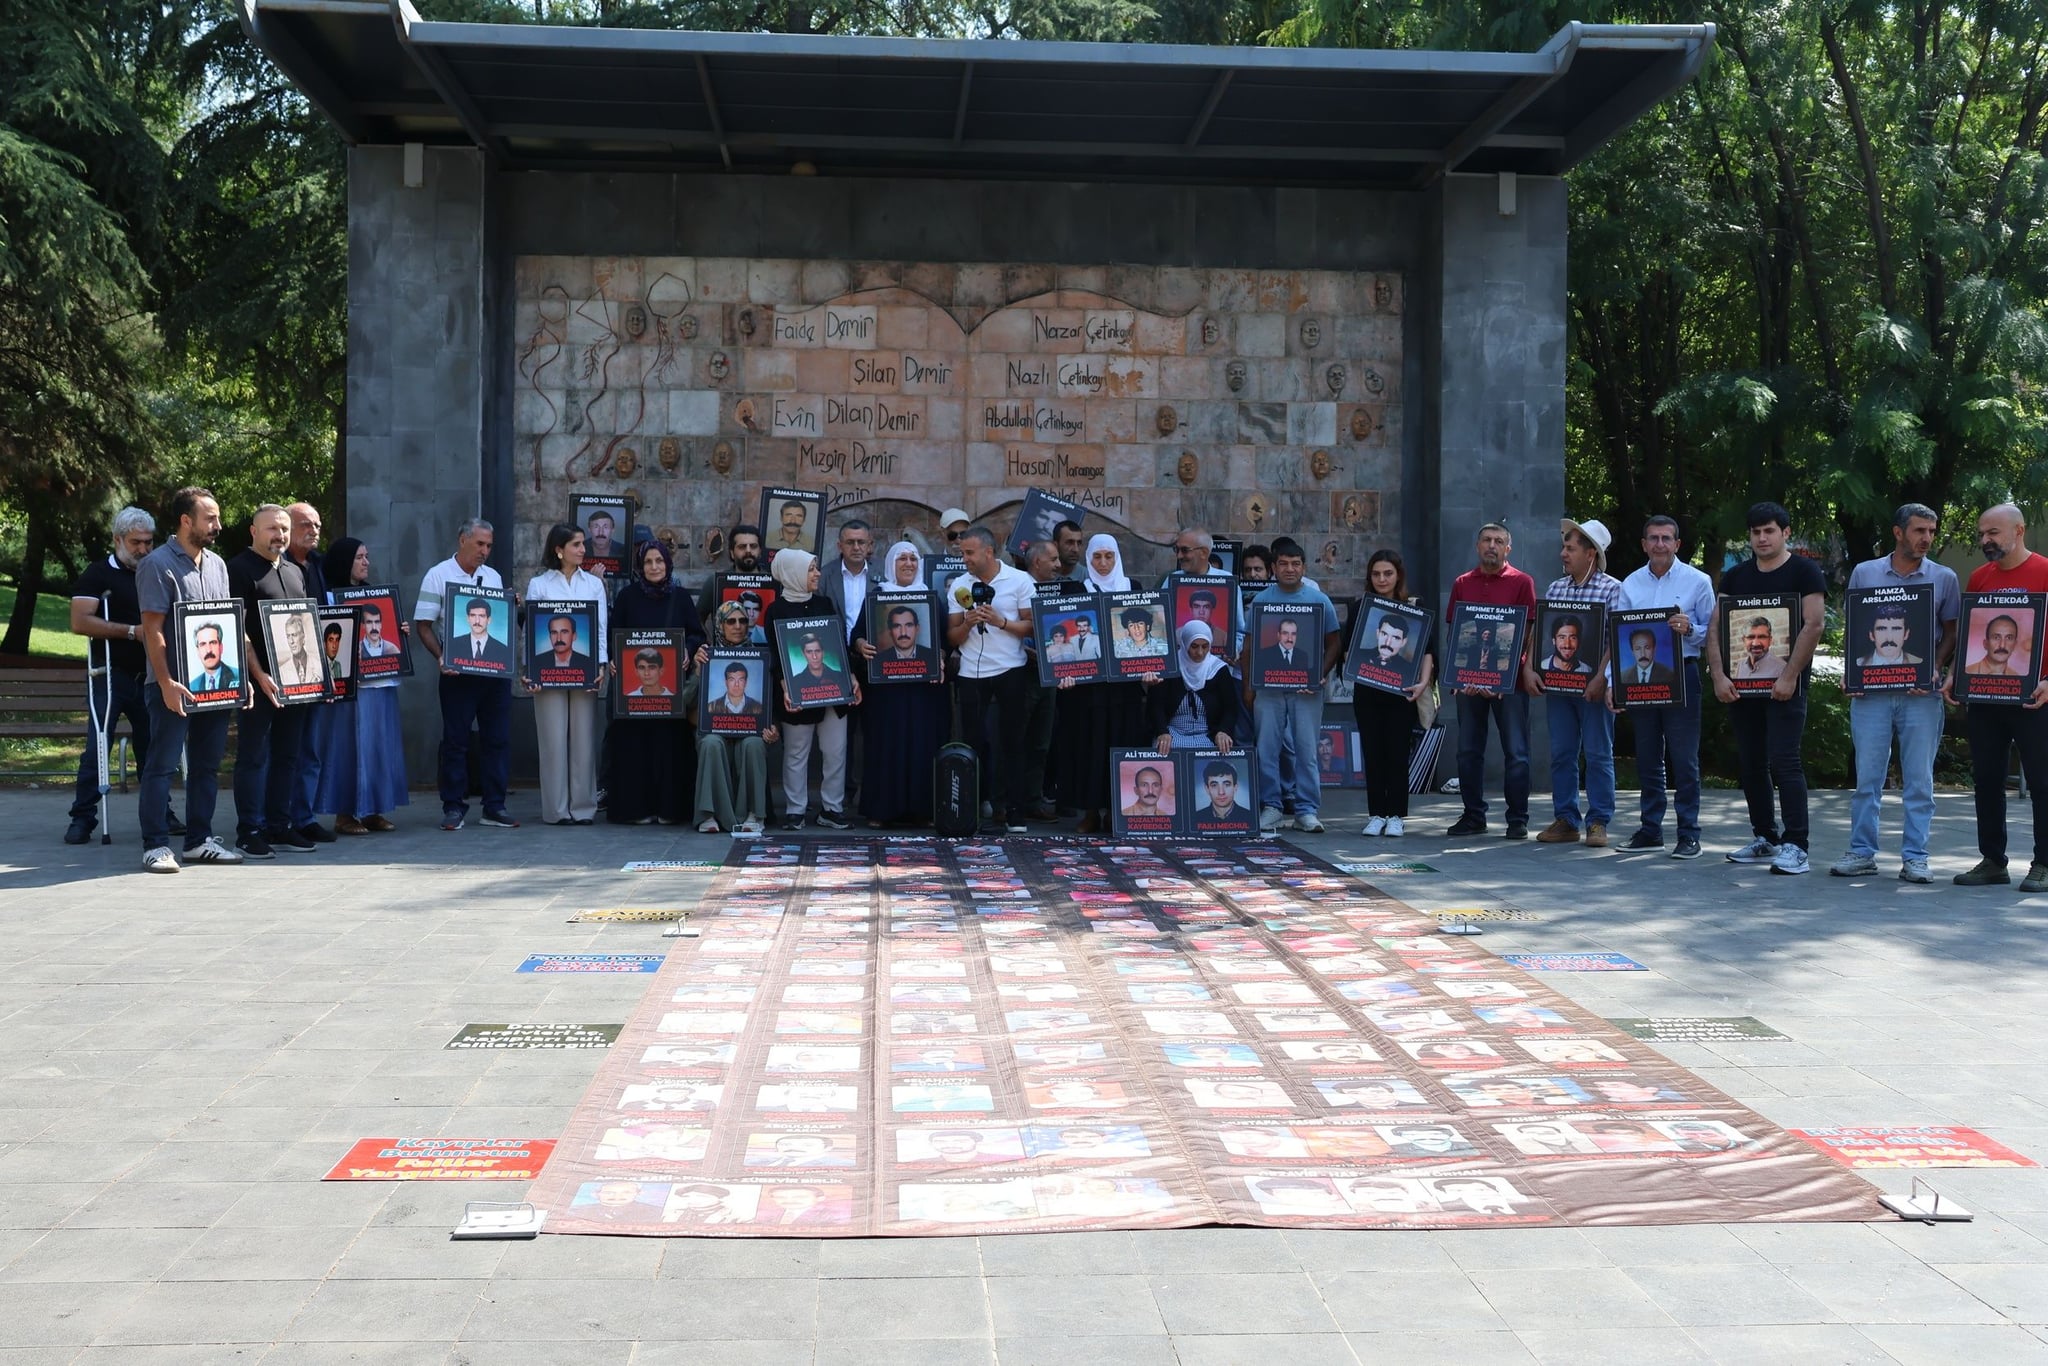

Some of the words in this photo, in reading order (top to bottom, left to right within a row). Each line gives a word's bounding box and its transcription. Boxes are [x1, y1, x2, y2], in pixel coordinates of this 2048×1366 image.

[827, 311, 874, 340] Demir
[1035, 315, 1083, 343] Nazar
[854, 358, 896, 386] Şilan
[904, 356, 952, 384] Demir
[1008, 360, 1050, 388] Nazlı
[827, 397, 873, 432] Dilan
[878, 403, 919, 431] Demir
[985, 406, 1033, 428] Abdullah
[1035, 408, 1083, 437] Çetinkaya
[853, 441, 898, 476] Demir
[1007, 450, 1055, 479] Hasan
[1057, 454, 1104, 480] Marangoz
[773, 489, 802, 497] RAMAZAN
[1080, 488, 1123, 515] Aslan
[344, 588, 365, 598] FEHMİ
[366, 588, 389, 597] TOSUN
[460, 586, 484, 596] METİN
[486, 590, 504, 598] CAN
[1874, 587, 1905, 595] HAMZA
[1043, 596, 1092, 605] ZOZAN-ORHAN
[1737, 597, 1761, 606] TAHİR
[1762, 596, 1781, 606] ELÇİ
[1862, 593, 1918, 604] ARSLANOĞLU
[1977, 596, 1992, 604] ALİ
[1993, 595, 2029, 604] TEKDAĞ
[187, 602, 205, 611] VEYSİ
[1263, 603, 1284, 612] FİKRİ
[1284, 604, 1313, 612] ÖZGEN
[1373, 597, 1398, 609] MEHMET
[1398, 604, 1424, 616] ÖZDEMİR
[1465, 604, 1495, 613] MEHMET
[1572, 603, 1591, 611] OCAK
[1474, 613, 1504, 621] AKDENİZ
[1622, 613, 1644, 621] VEDAT
[786, 620, 803, 629] EDİP
[804, 619, 829, 628] AKSOY
[626, 637, 672, 645] DEMİRKIRAN
[1124, 750, 1137, 758] ALİ
[395, 1138, 530, 1149] Kayıplar
[378, 1149, 531, 1158] Bulunsun
[395, 1158, 501, 1168] Failler
[349, 1168, 532, 1180] Yargılansın
